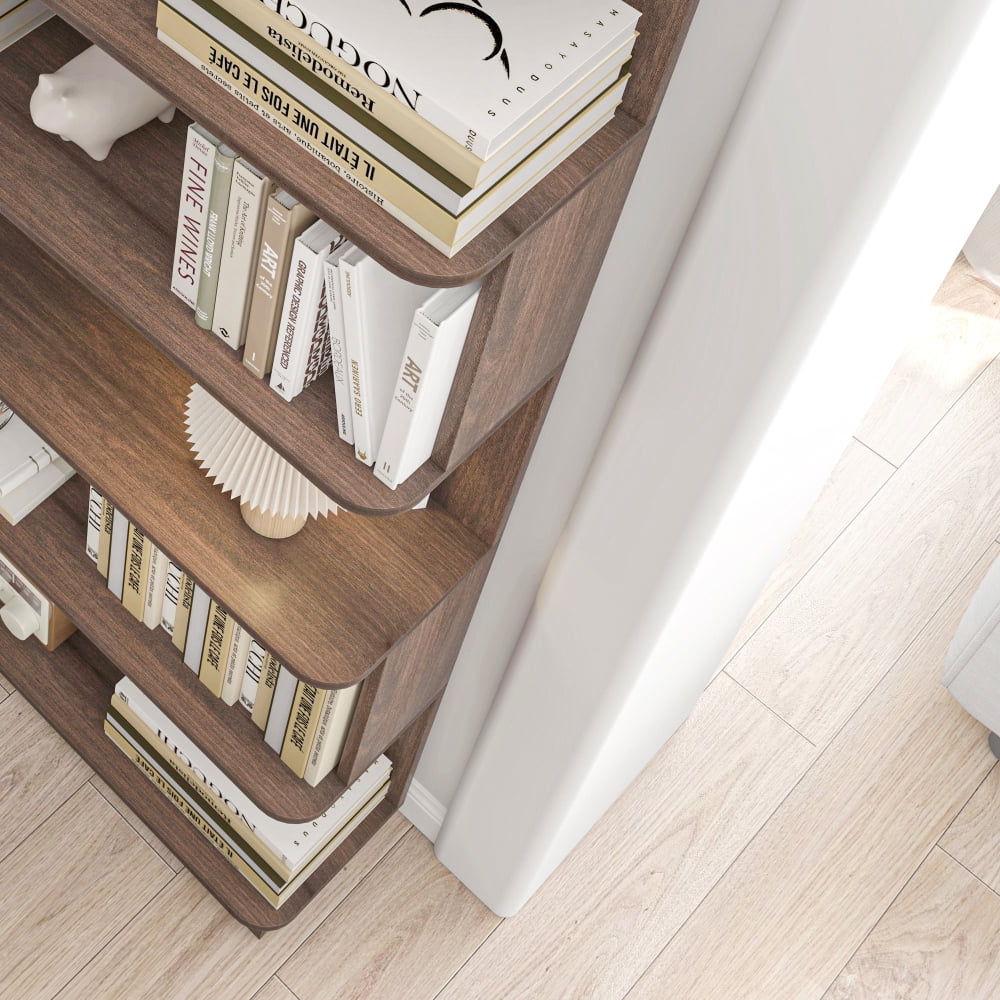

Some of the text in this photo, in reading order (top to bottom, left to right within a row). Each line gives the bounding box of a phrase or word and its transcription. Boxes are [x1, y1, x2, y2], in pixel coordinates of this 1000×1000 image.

[267, 24, 377, 114] Remodelista
[487, 8, 619, 118] MASAYO DUUS
[208, 45, 376, 181] IL ÉTAIT UNE FOIS LE CAFÉ
[234, 89, 260, 111] petits
[272, 117, 292, 136] arts
[343, 168, 385, 206] Histoire,
[177, 156, 208, 286] FINE WINES
[260, 241, 279, 279] ART
[280, 259, 307, 370] GRAPHIC DESIGN REFERENCED
[350, 359, 363, 417] EERO SAARINEN
[401, 355, 423, 394] ART
